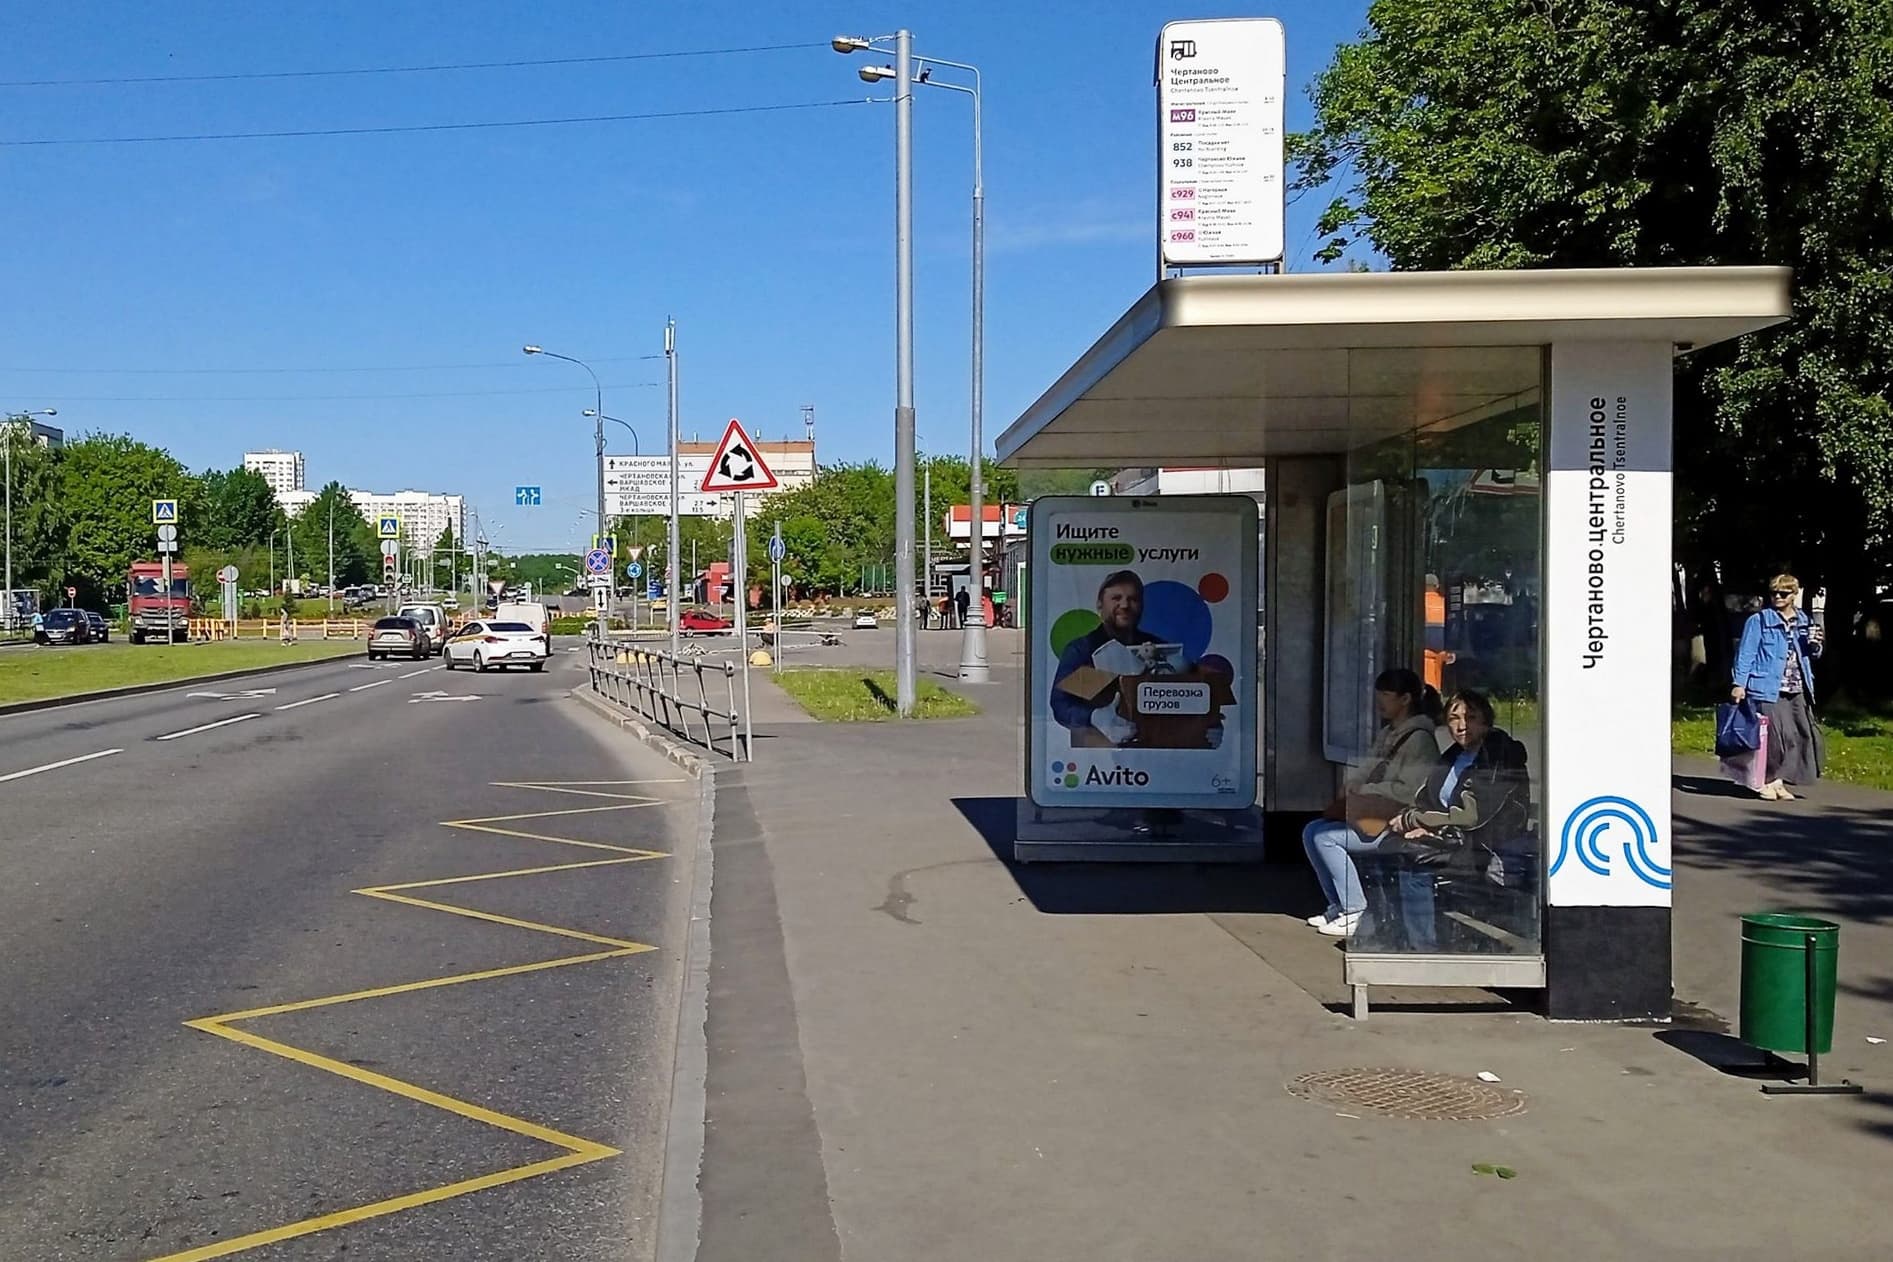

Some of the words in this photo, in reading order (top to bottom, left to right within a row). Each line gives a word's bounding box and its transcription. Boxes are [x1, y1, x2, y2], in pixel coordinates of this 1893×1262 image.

[1170, 68, 1219, 77] Чертаново
[1170, 77, 1231, 86] Центральное
[1173, 142, 1193, 152] 852
[1173, 159, 1193, 168] 938
[1171, 190, 1194, 199] с929
[1171, 211, 1194, 220] с941
[1171, 232, 1194, 241] с960
[1613, 396, 1627, 471] Tsentralnoe
[1611, 472, 1626, 545] Chertanovo
[1056, 523, 1119, 541] Ищите
[1056, 548, 1129, 562] нужные
[1138, 548, 1199, 563] услуги
[1143, 687, 1204, 699] Перевозка
[1143, 701, 1180, 710] грузов
[1085, 764, 1149, 786] Avito
[1211, 775, 1232, 788] 6+
